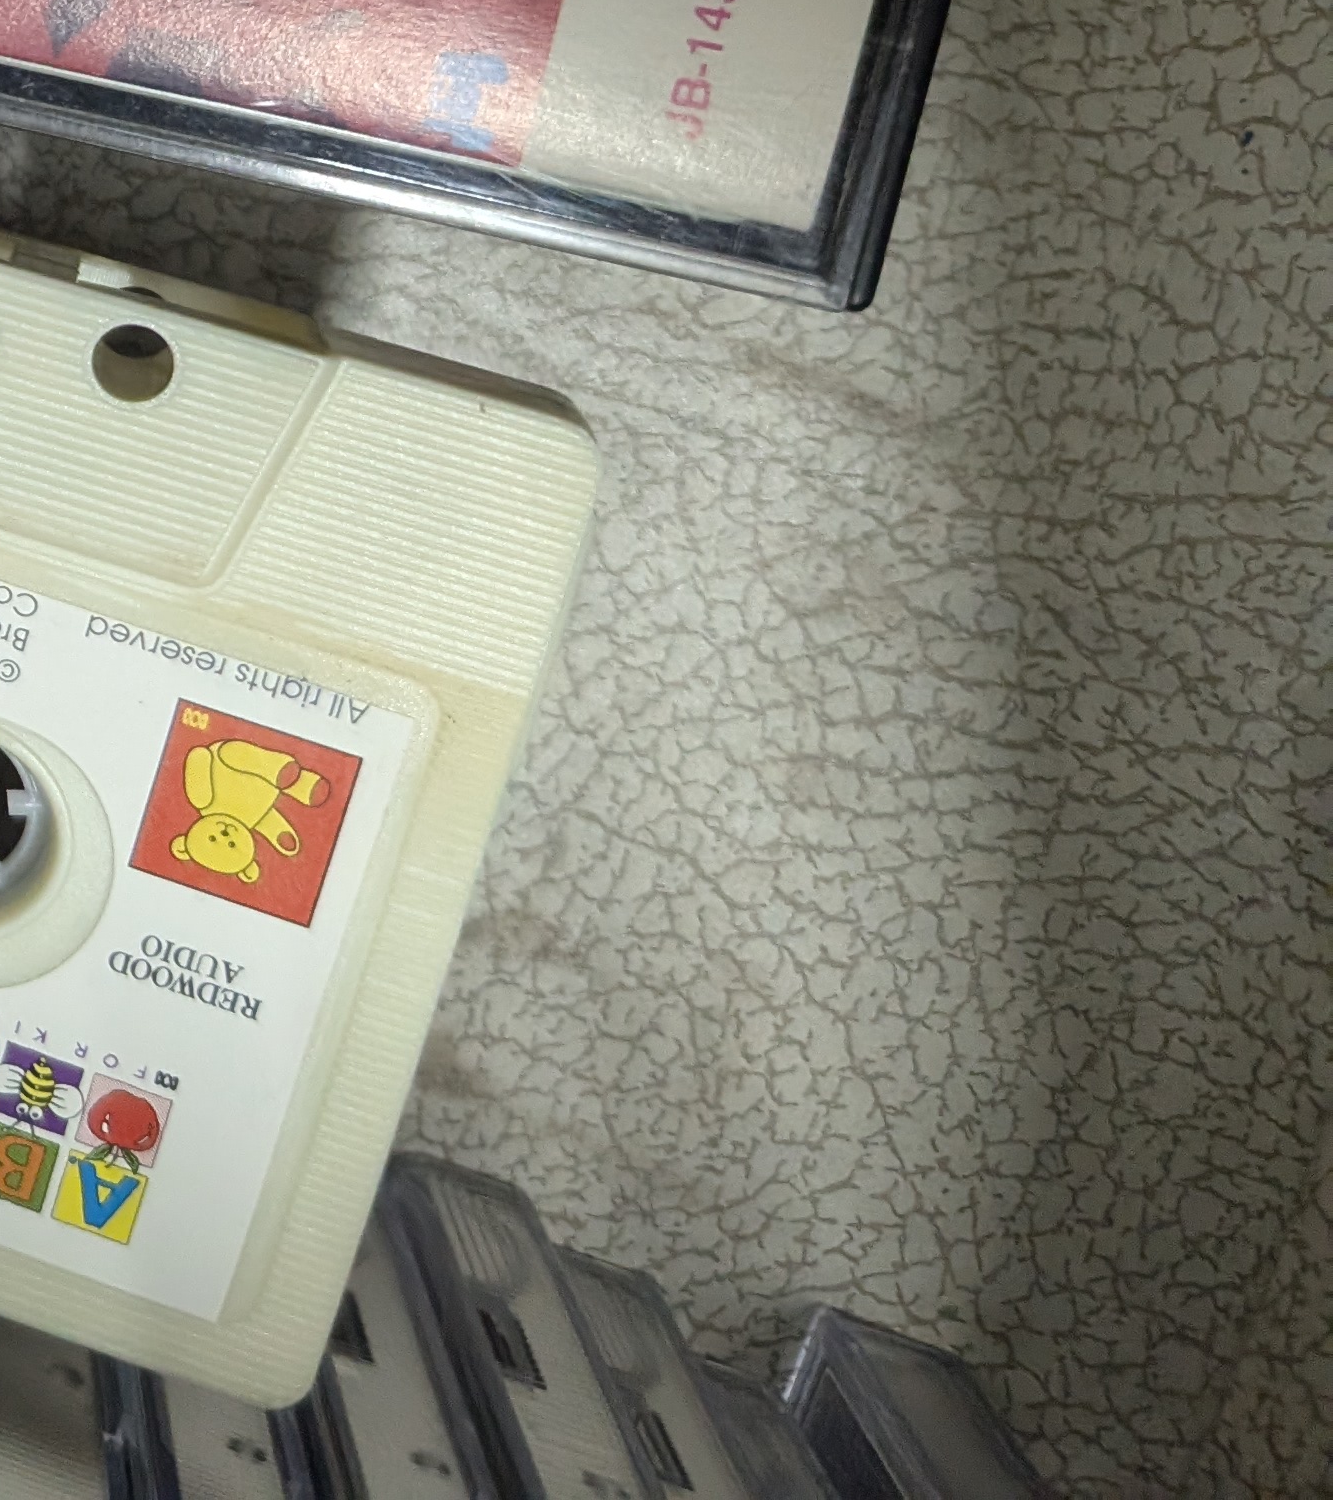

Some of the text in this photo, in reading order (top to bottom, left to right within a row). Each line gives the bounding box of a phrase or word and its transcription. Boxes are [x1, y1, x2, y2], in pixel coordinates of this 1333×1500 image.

[82, 612, 371, 726] All rights reserved
[102, 945, 265, 1021] REDWOOD
[136, 930, 245, 987] AUDIO
[70, 1038, 148, 1078] FOR
